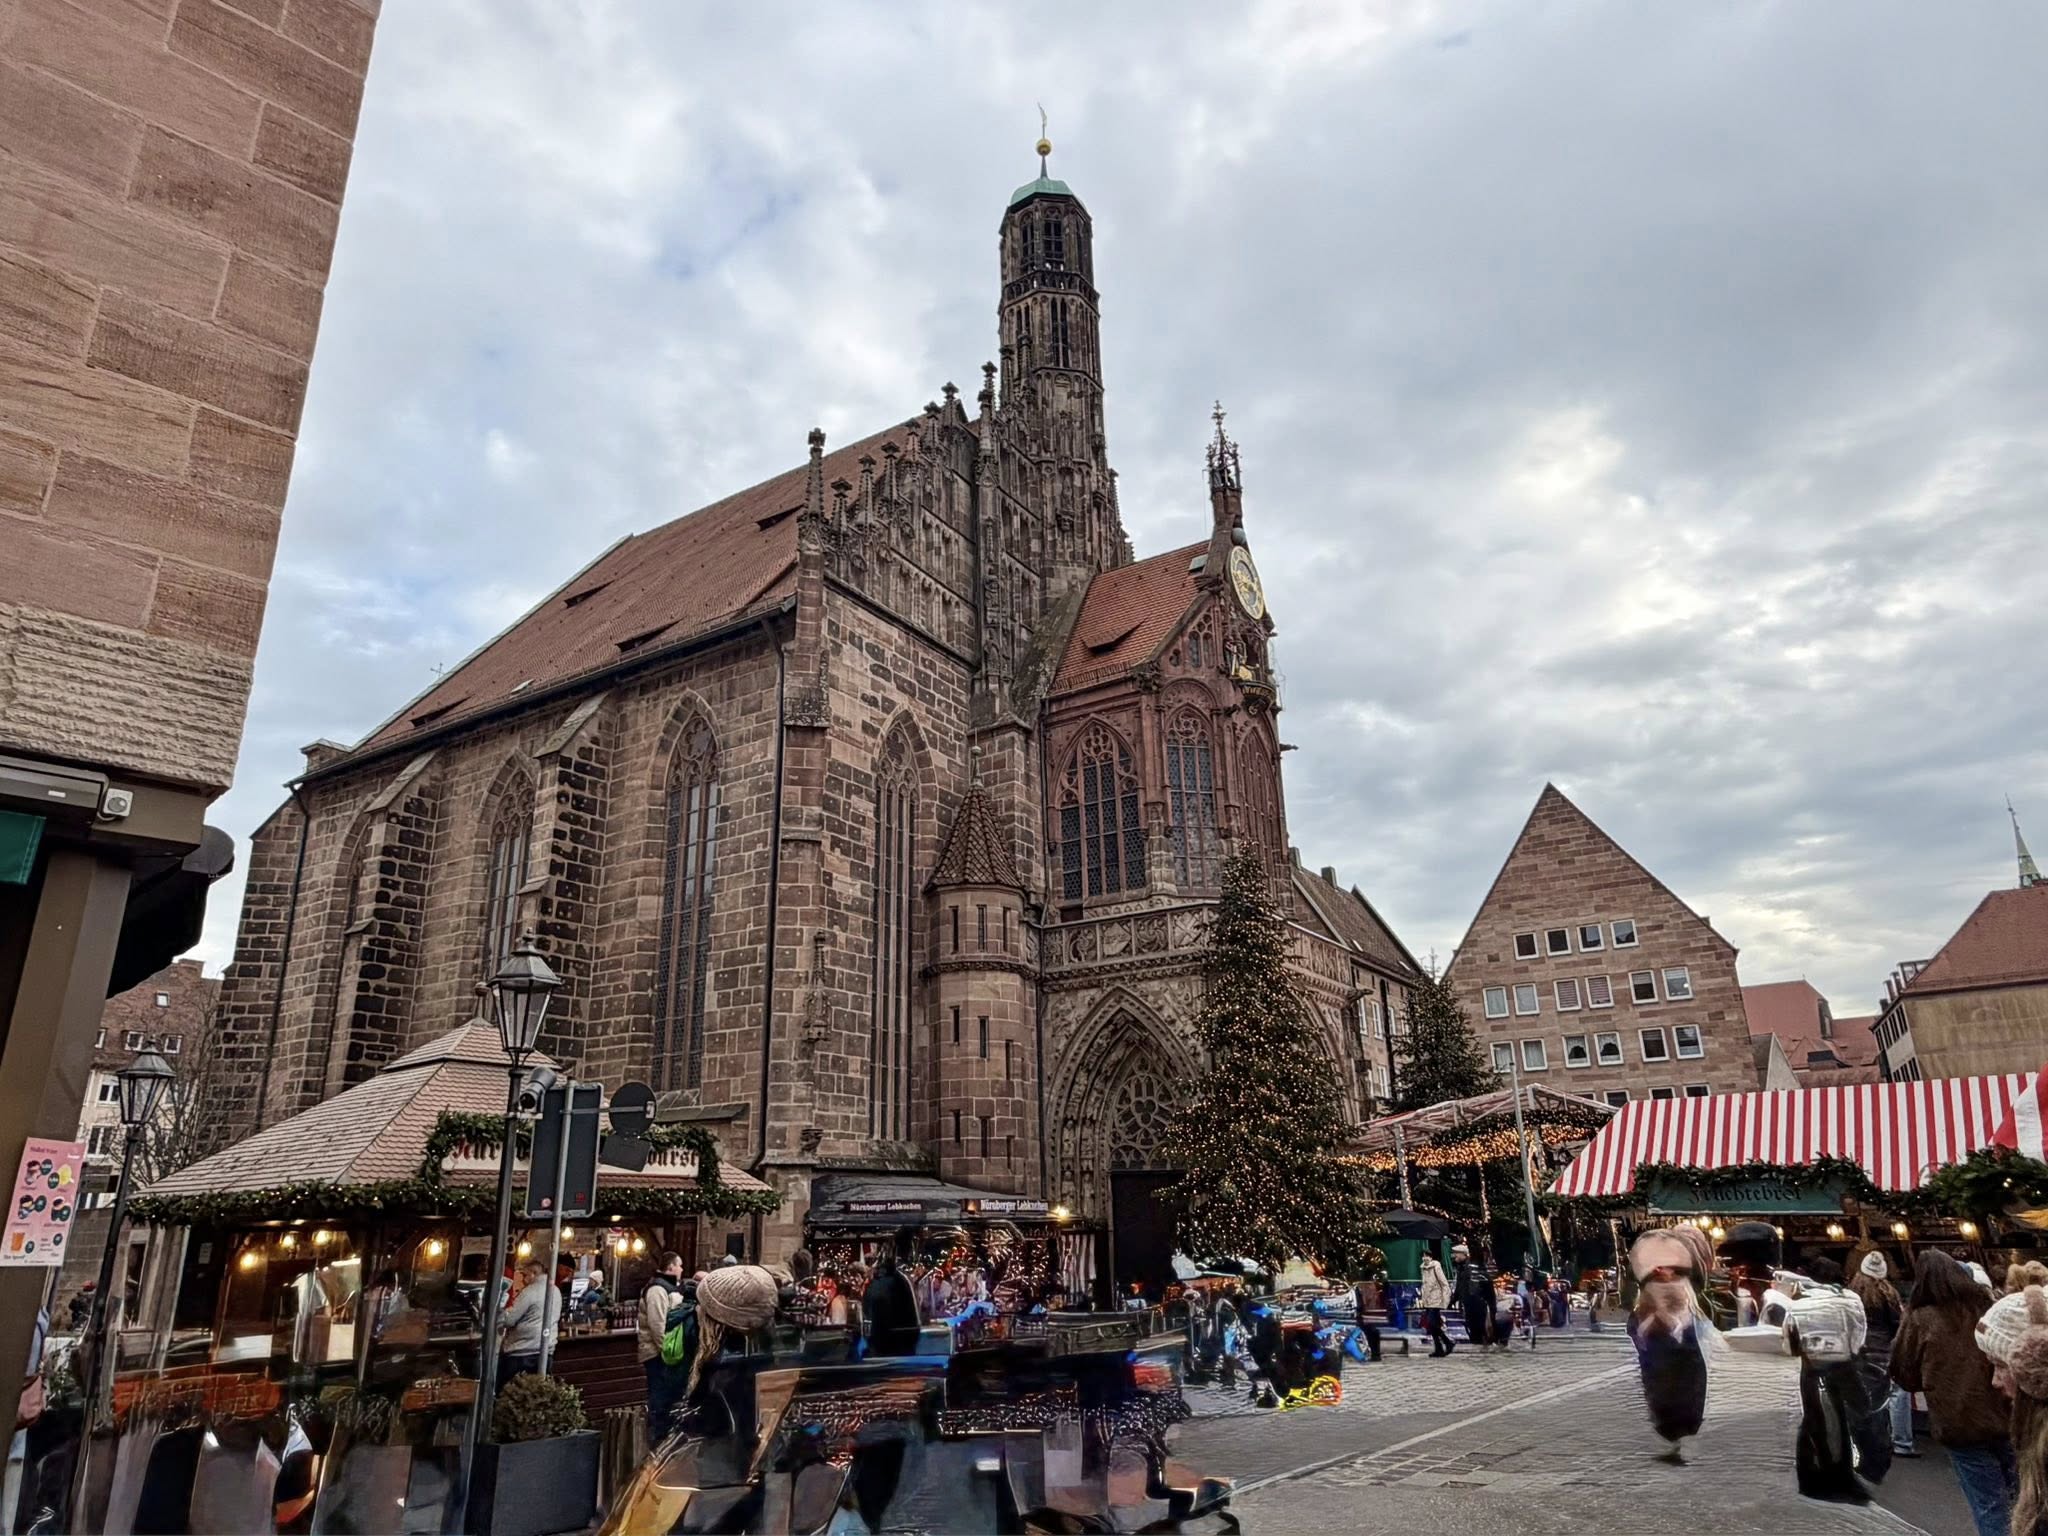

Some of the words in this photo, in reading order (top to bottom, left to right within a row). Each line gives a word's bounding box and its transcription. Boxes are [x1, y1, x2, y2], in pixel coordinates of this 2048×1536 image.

[850, 1203, 887, 1212] Nürnberger
[887, 1202, 922, 1211] Lebkuchen
[981, 1199, 1016, 1213] Nürnberger
[1017, 1199, 1049, 1211] Lebkuchen
